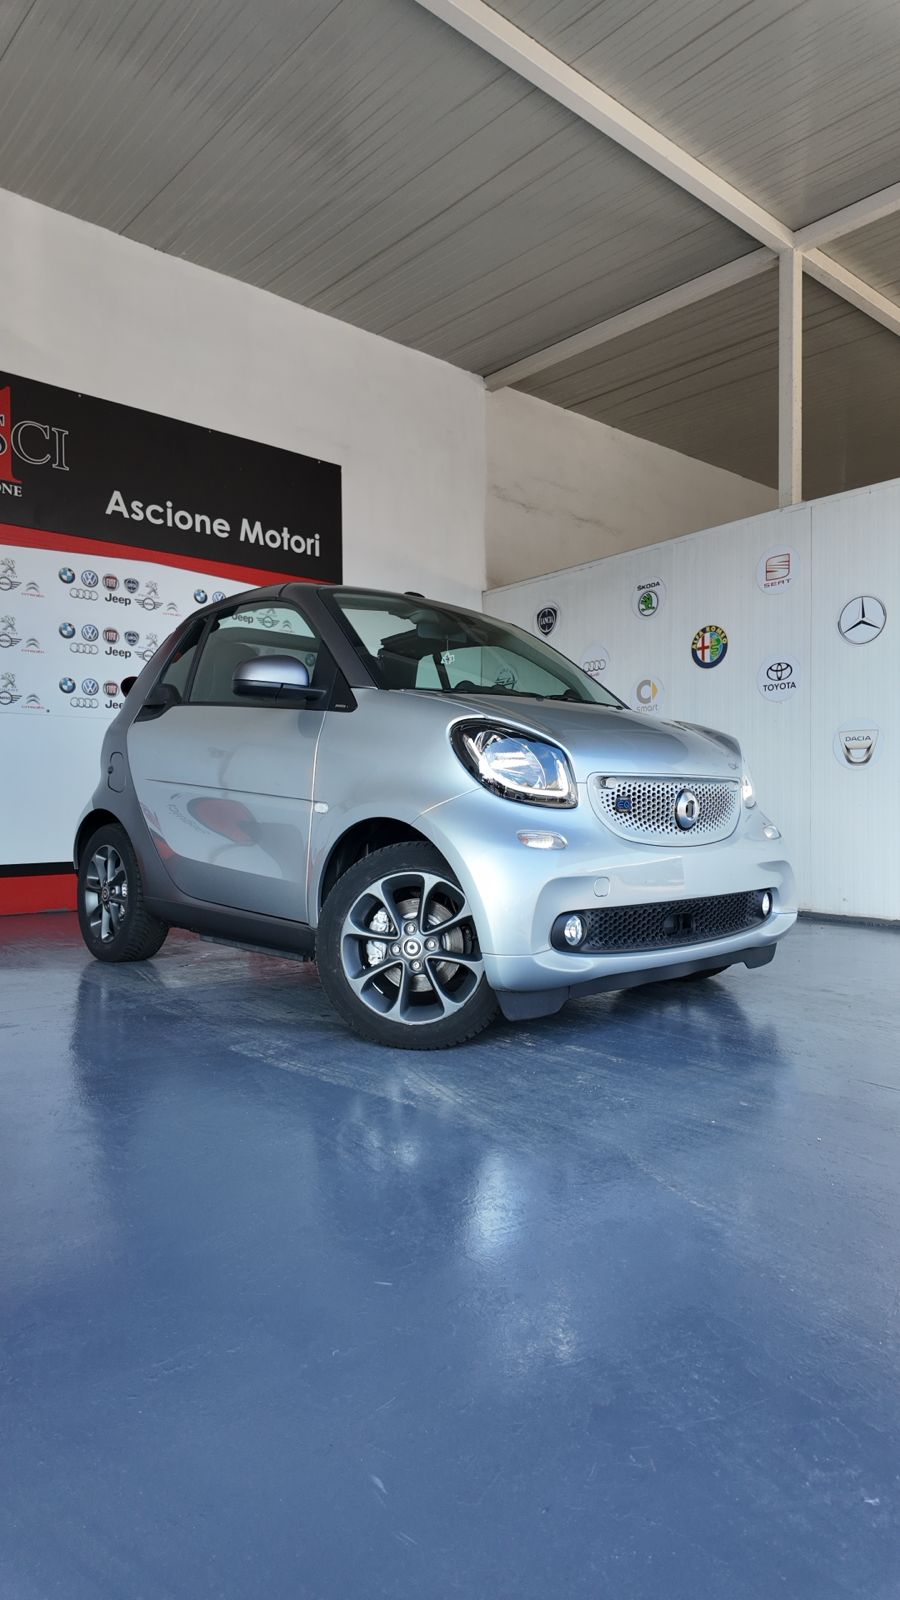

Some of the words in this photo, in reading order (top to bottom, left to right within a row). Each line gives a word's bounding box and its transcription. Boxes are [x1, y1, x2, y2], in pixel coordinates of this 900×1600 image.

[105, 490, 231, 538] Ascione
[239, 518, 320, 557] Motori
[763, 578, 792, 589] SEAT
[104, 593, 132, 606] Jeep
[104, 646, 132, 659] Jeep
[763, 681, 797, 692] TOYOTA
